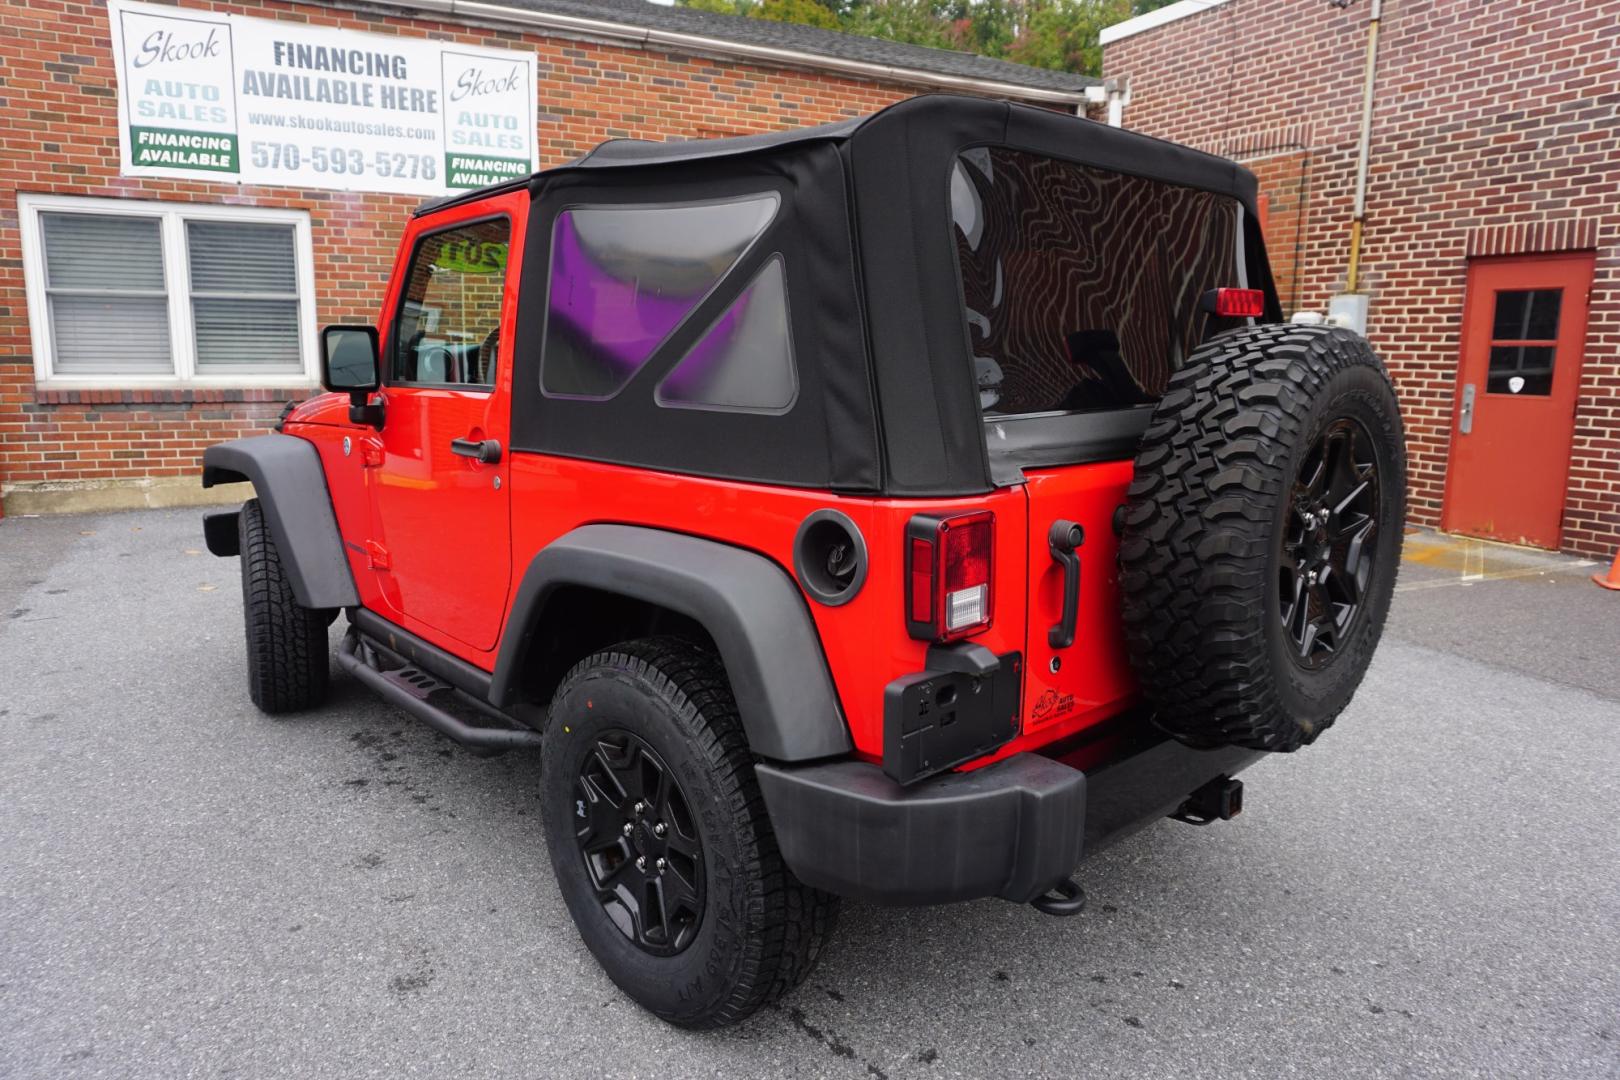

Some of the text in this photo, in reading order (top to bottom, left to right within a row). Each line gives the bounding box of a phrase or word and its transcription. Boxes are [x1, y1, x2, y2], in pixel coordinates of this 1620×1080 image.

[133, 28, 219, 69] Skook
[273, 40, 407, 80] FINANCING
[144, 79, 220, 101] AUTO
[243, 69, 438, 114] AVAILABLE HERE
[450, 65, 519, 102] Skook
[137, 100, 227, 123] SALES
[458, 111, 518, 130] AUTO
[248, 111, 436, 141] www.skookautosales.com
[138, 131, 231, 151] FINANCING
[452, 130, 524, 150] SALES
[140, 149, 230, 167] AVAILABLE
[251, 140, 436, 181] 570-593-5278
[452, 157, 526, 174] FINANCING
